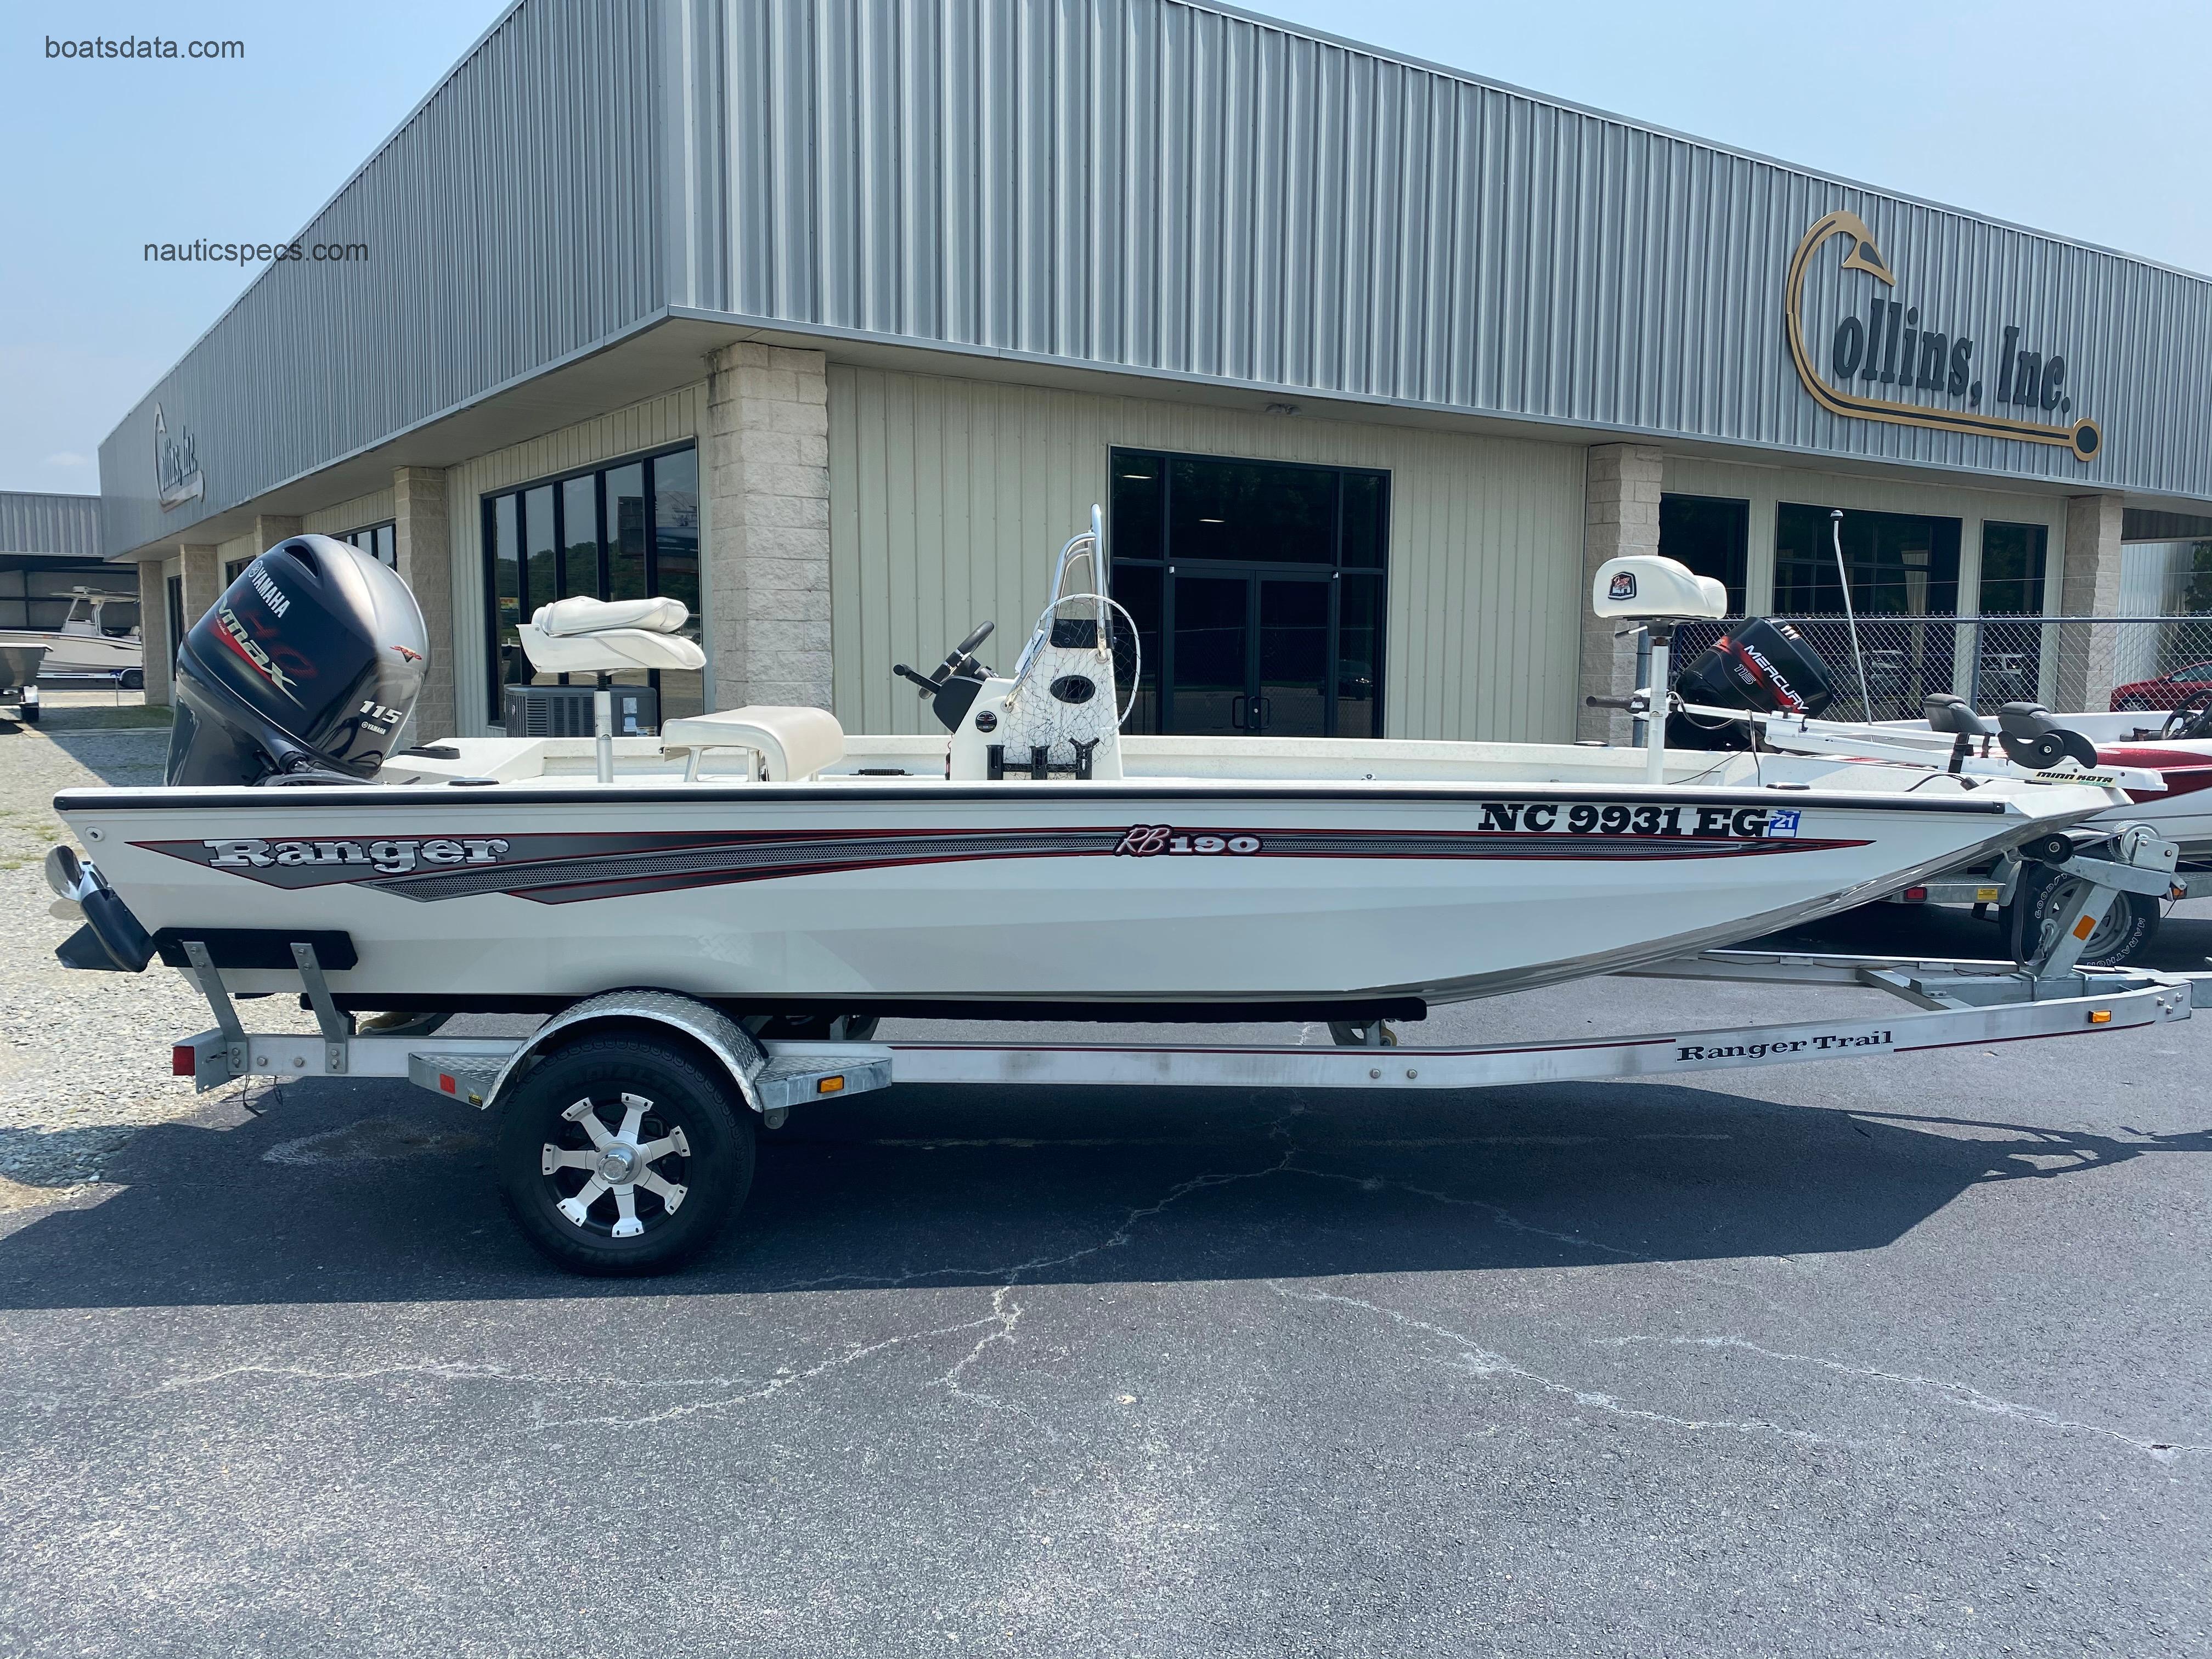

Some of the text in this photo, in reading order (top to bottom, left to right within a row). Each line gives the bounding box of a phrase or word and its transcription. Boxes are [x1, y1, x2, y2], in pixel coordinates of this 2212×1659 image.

[1997, 325, 2071, 414] Inc.
[252, 567, 290, 618] YAMAHA
[1734, 663, 1757, 685] 115
[1743, 645, 1809, 710] MERCURY
[359, 700, 403, 724] 115
[367, 723, 386, 735] YAMAHA
[2076, 775, 2114, 783] KOTA
[1477, 803, 1770, 837] NC 9931 EG
[1774, 813, 1795, 828] 21
[204, 839, 509, 873] Ranger
[1677, 1031, 1894, 1062] Ranger Trail
